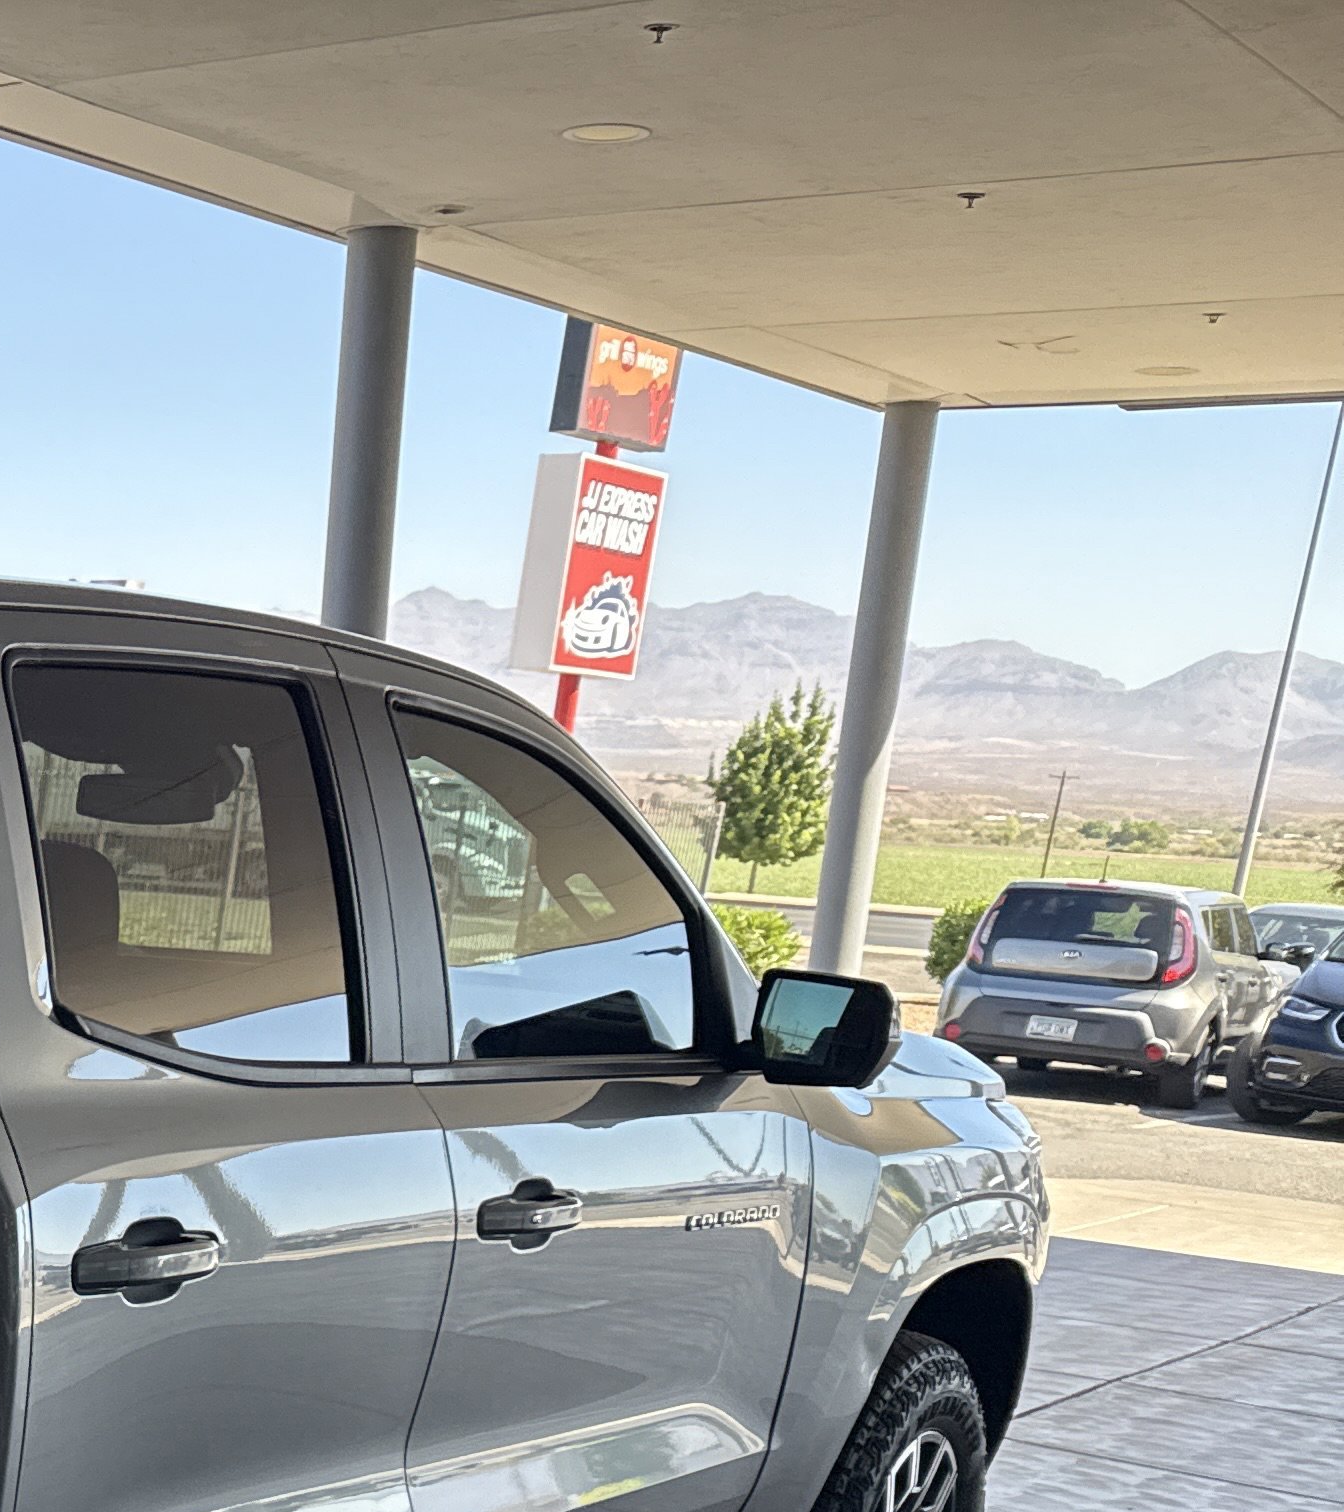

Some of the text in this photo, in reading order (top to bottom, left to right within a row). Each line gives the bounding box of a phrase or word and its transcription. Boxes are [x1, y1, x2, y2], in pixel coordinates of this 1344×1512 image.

[582, 479, 658, 523] JJ EXPRESS
[575, 509, 650, 556] CAR WASH
[685, 1205, 780, 1231] COLORADO
